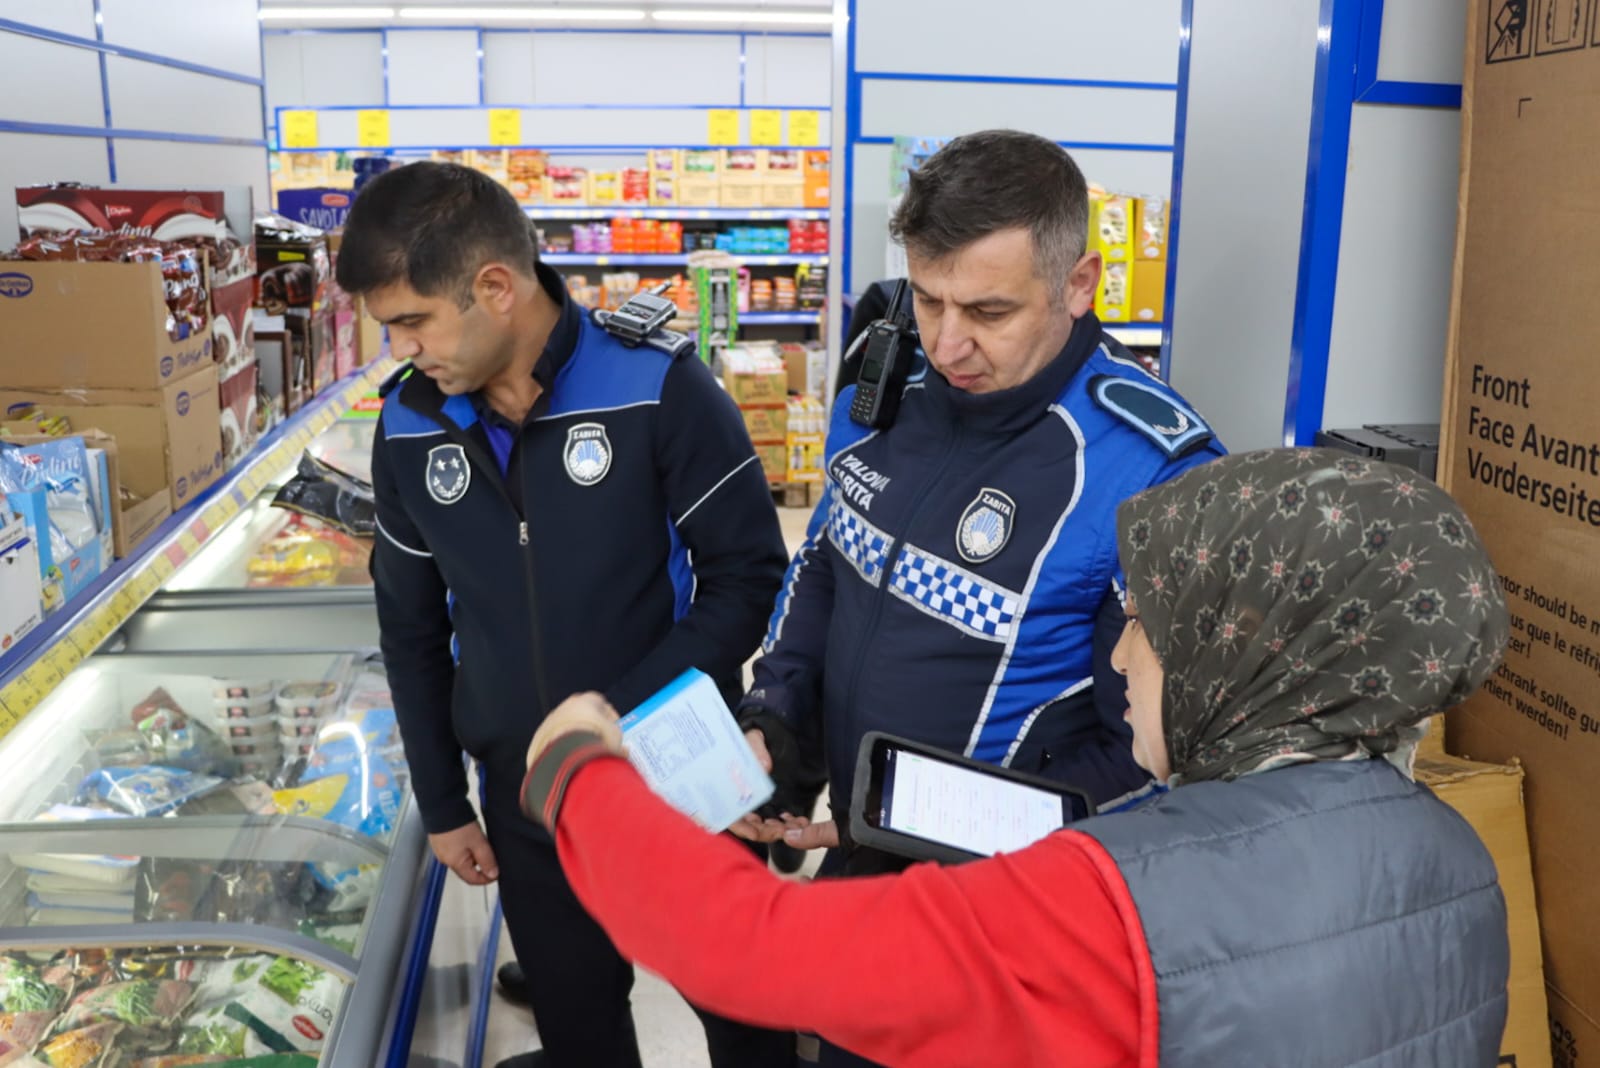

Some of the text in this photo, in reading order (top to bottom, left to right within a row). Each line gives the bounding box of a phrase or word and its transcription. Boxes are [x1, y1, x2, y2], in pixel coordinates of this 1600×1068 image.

[300, 207, 351, 230] SAVOIA
[1472, 364, 1531, 408] Front
[1468, 406, 1600, 476] Face Avant
[840, 453, 892, 492] YALOVA
[1467, 447, 1600, 527] Vorderseite
[1523, 585, 1567, 619] should
[1569, 605, 1588, 629] be
[1526, 623, 1551, 646] que
[1554, 631, 1567, 654] le
[1569, 643, 1600, 677] réfri
[1496, 662, 1600, 735] chrank sollte gu
[1515, 699, 1569, 741] werden!
